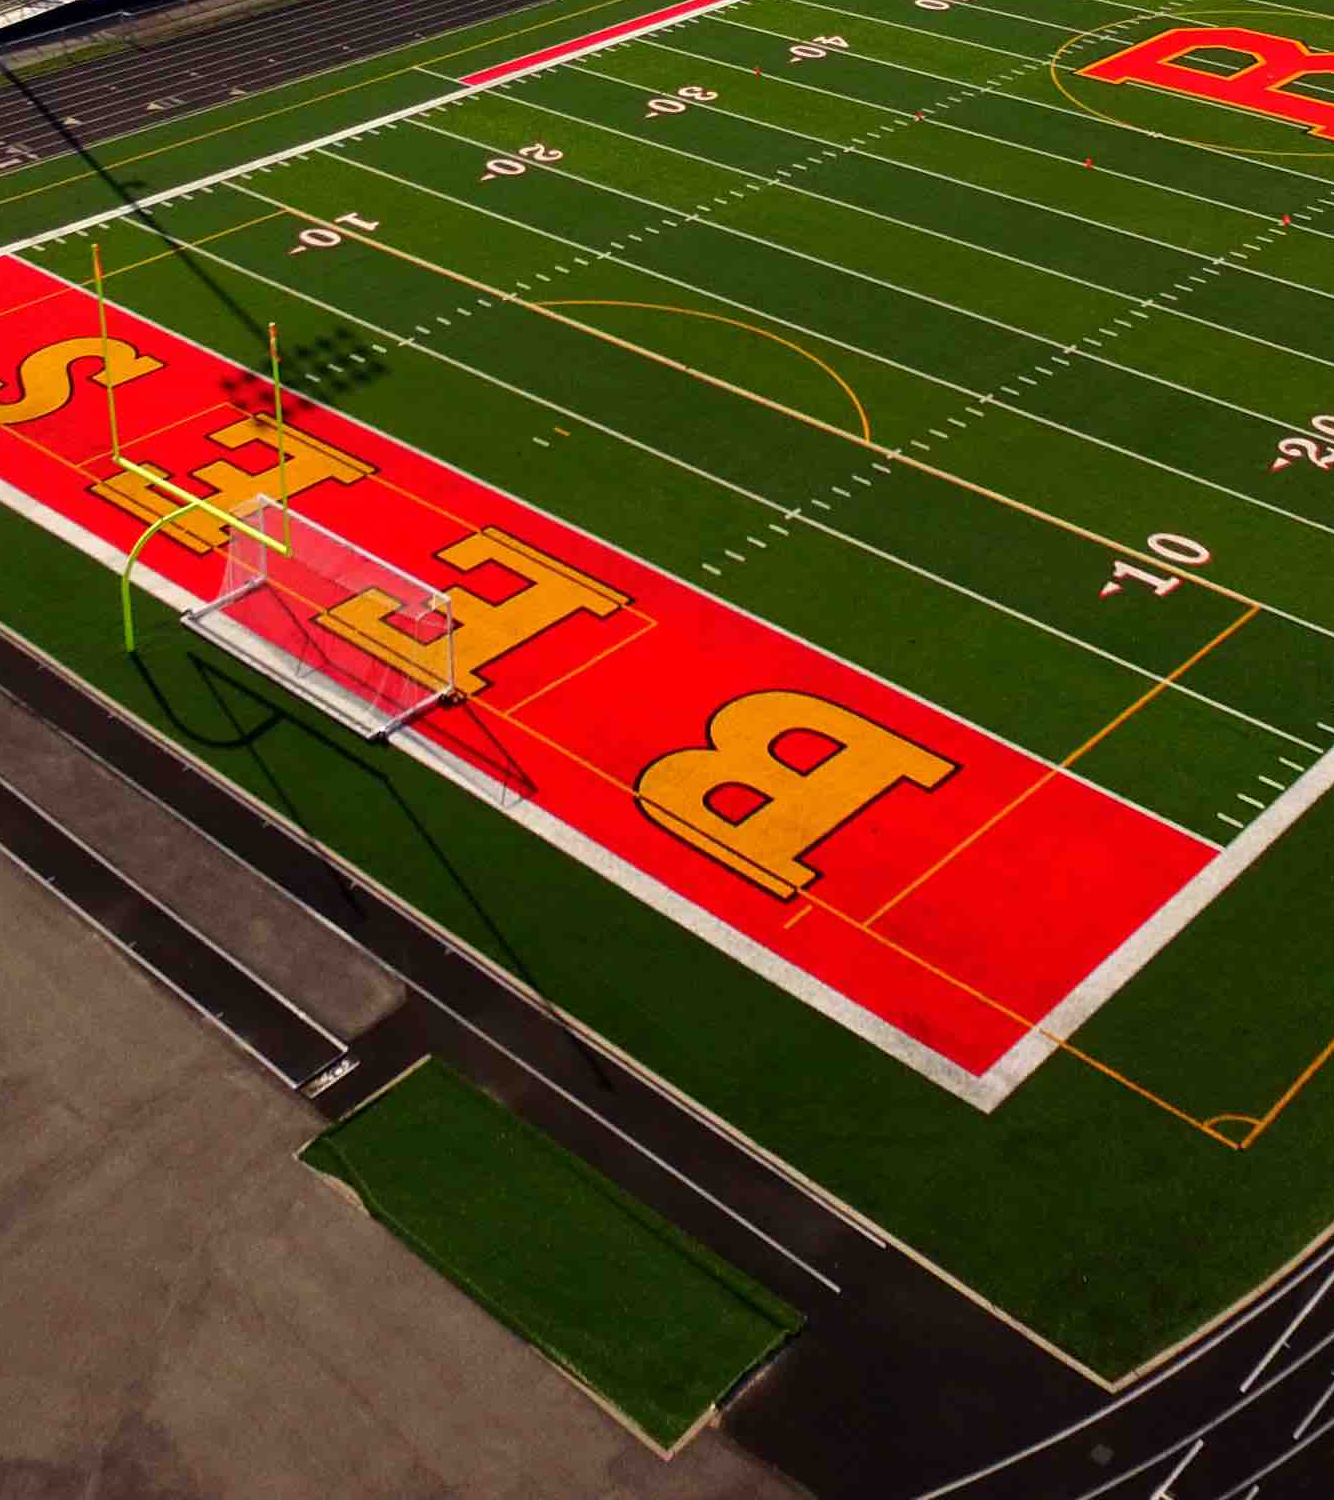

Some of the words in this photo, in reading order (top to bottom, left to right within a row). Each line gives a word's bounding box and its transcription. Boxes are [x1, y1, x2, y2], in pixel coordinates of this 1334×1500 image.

[791, 34, 850, 63] 40
[652, 84, 719, 117] 30
[485, 141, 564, 178] 20
[298, 210, 380, 249] 10
[1113, 531, 1213, 598] 10
